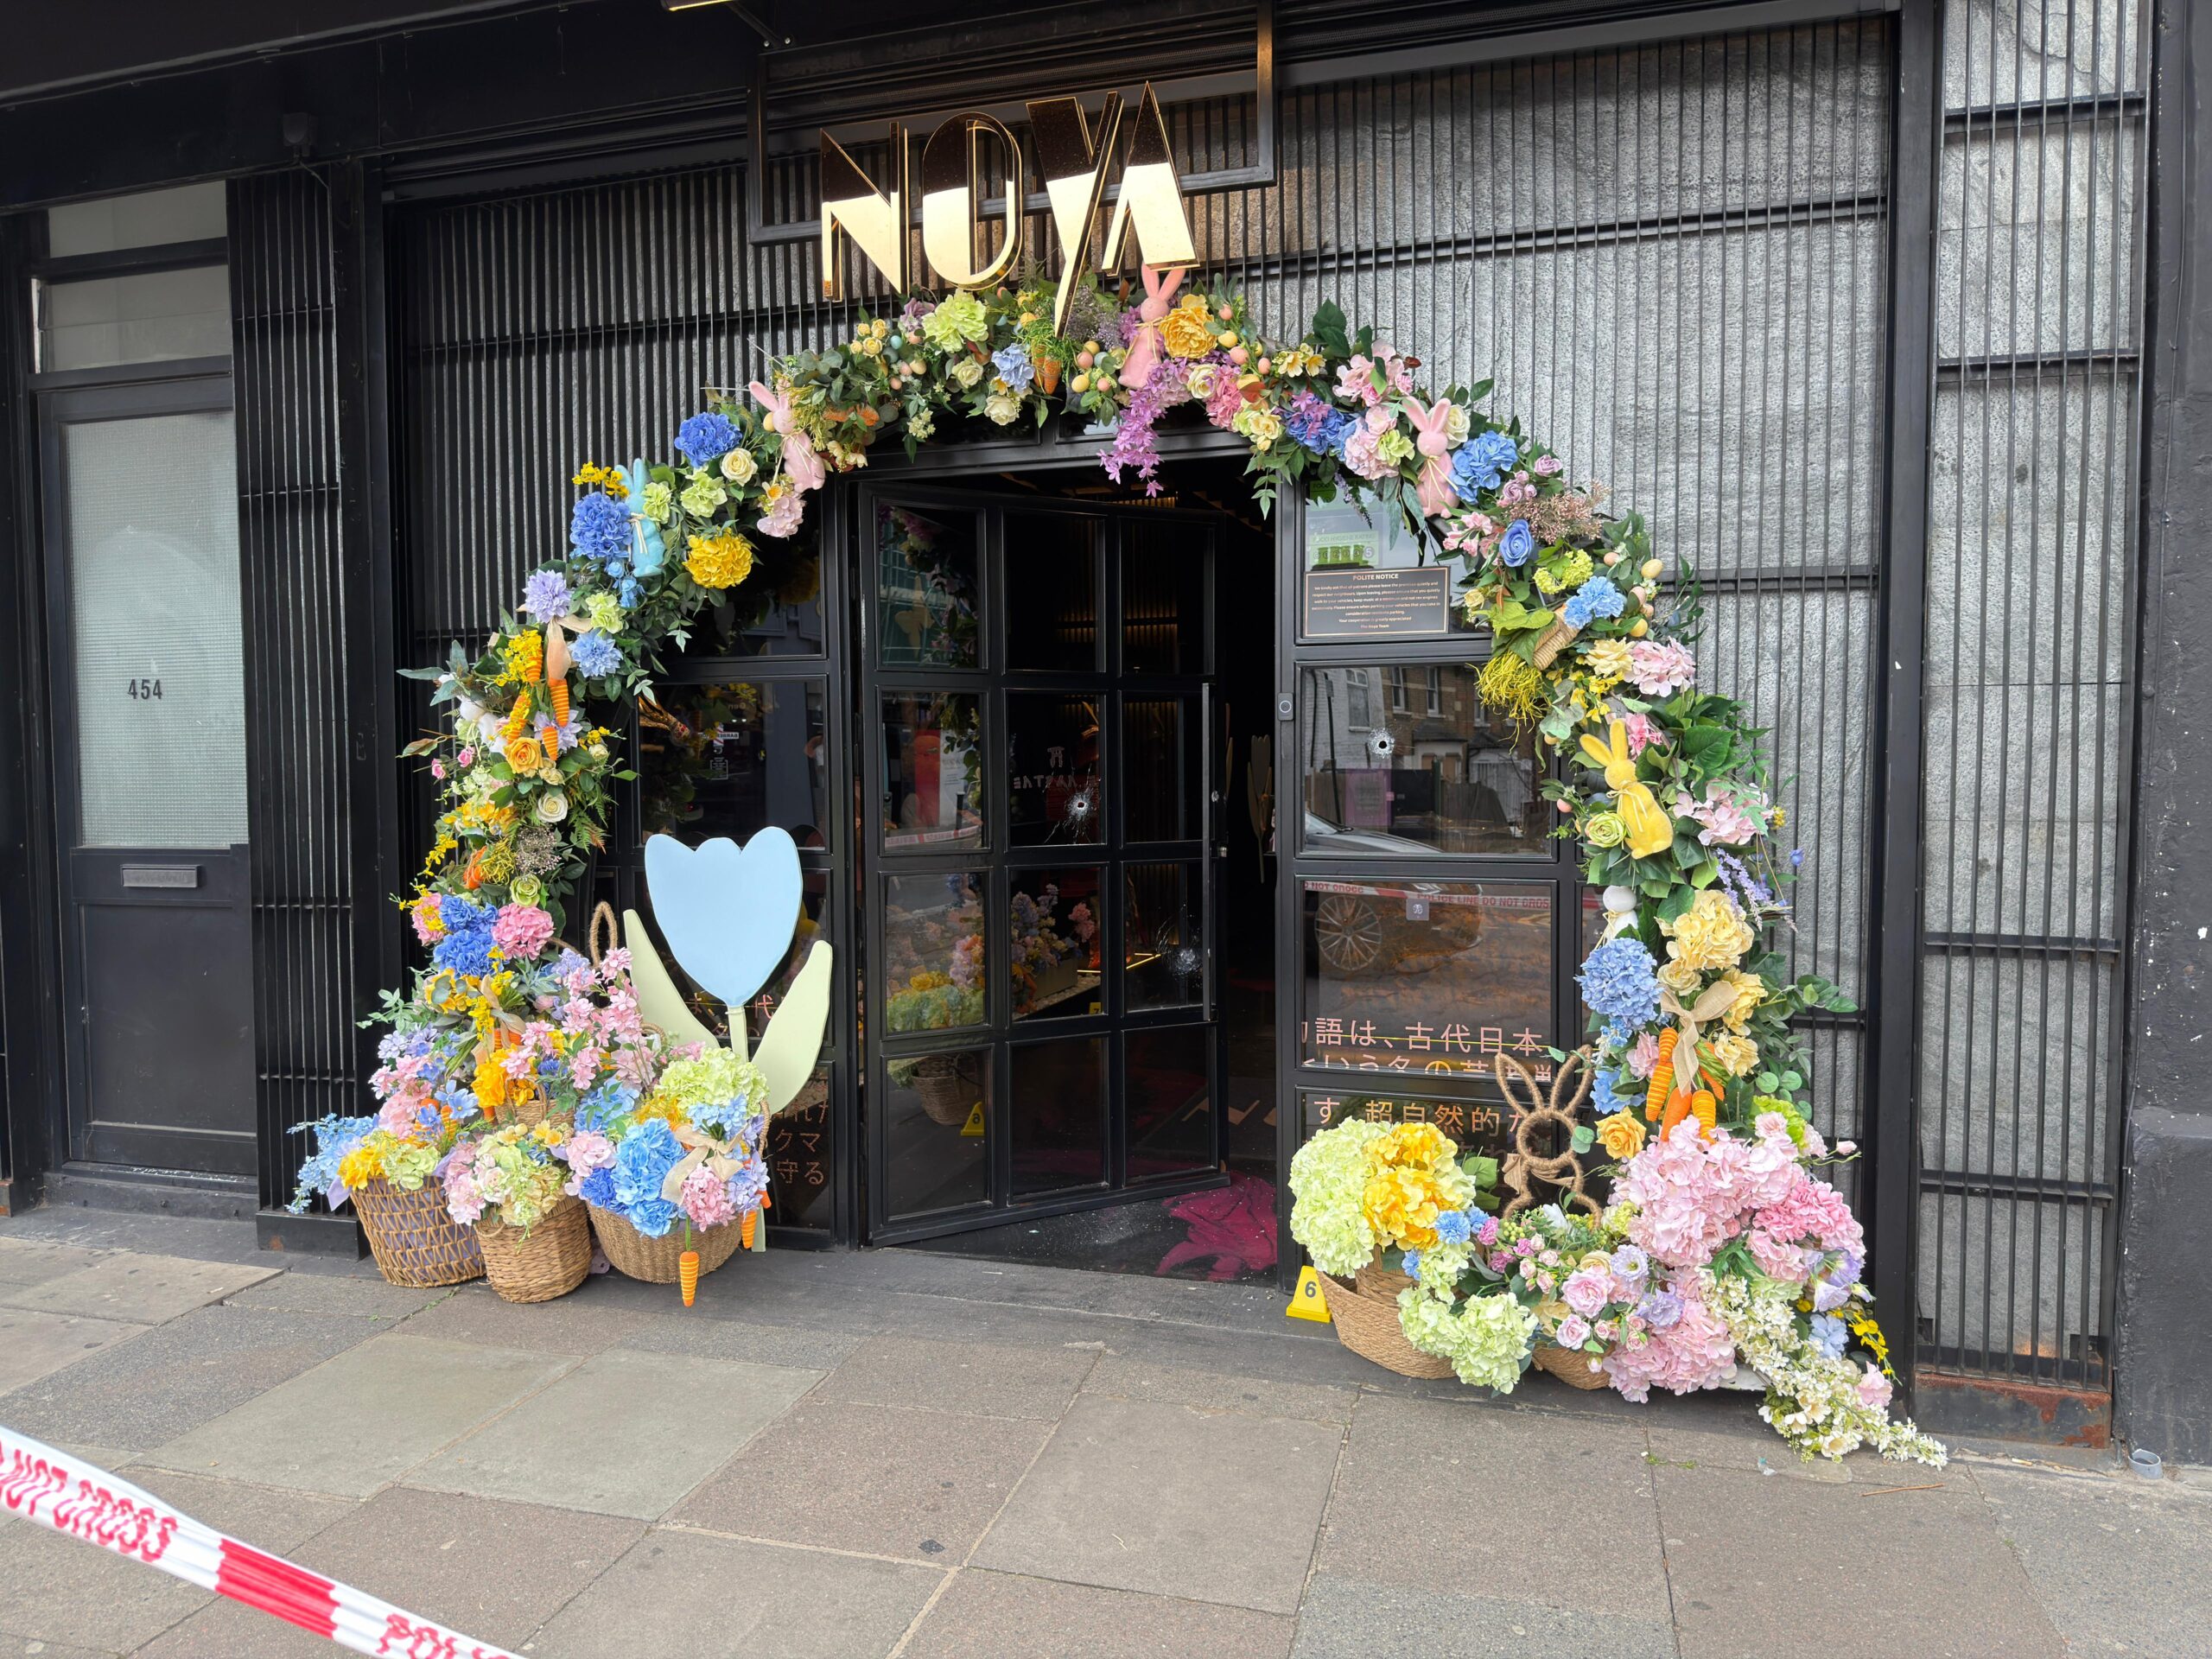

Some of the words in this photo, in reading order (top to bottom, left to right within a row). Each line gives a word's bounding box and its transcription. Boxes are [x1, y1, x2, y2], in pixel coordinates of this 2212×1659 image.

[127, 679, 162, 700] 454
[1458, 895, 1479, 905] LINE
[1482, 897, 1497, 906] DO
[1500, 898, 1519, 907] NOT
[776, 1159, 824, 1185] 守る
[1304, 1281, 1317, 1299] 6
[53, 1478, 178, 1563] CROSS
